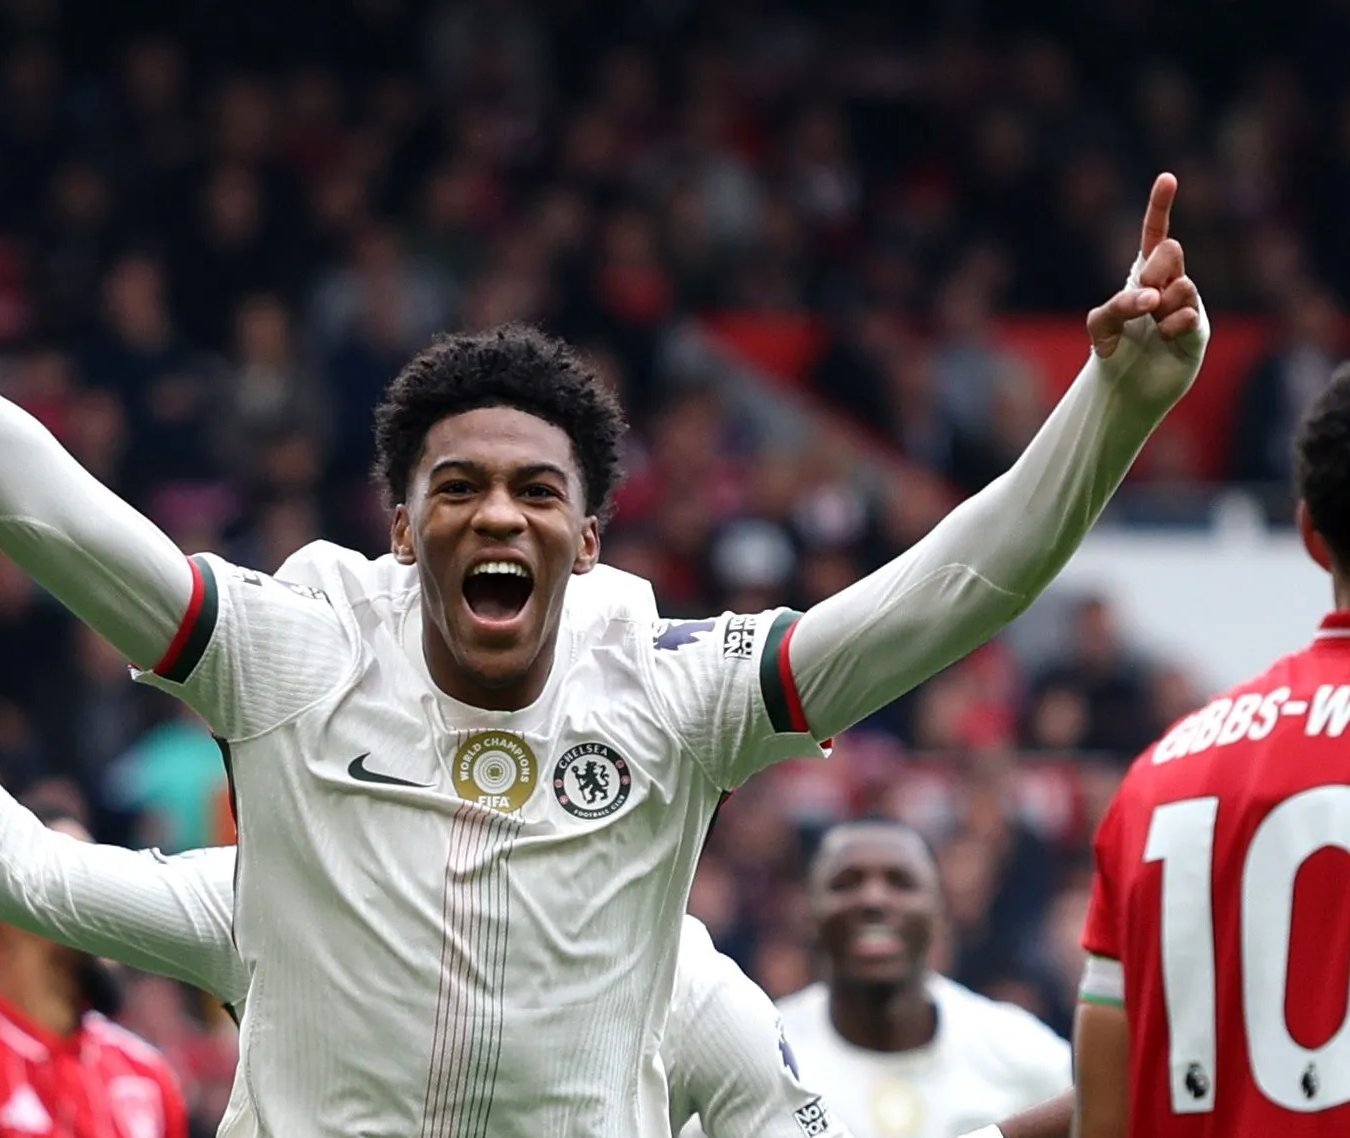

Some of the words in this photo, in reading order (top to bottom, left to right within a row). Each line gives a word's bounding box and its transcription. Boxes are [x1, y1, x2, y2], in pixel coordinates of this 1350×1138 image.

[460, 743, 482, 782] WORLD
[483, 738, 530, 783] CHAMPIONS
[558, 744, 608, 769] CHELSEA
[478, 795, 510, 808] FIFA
[795, 1104, 821, 1129] No
